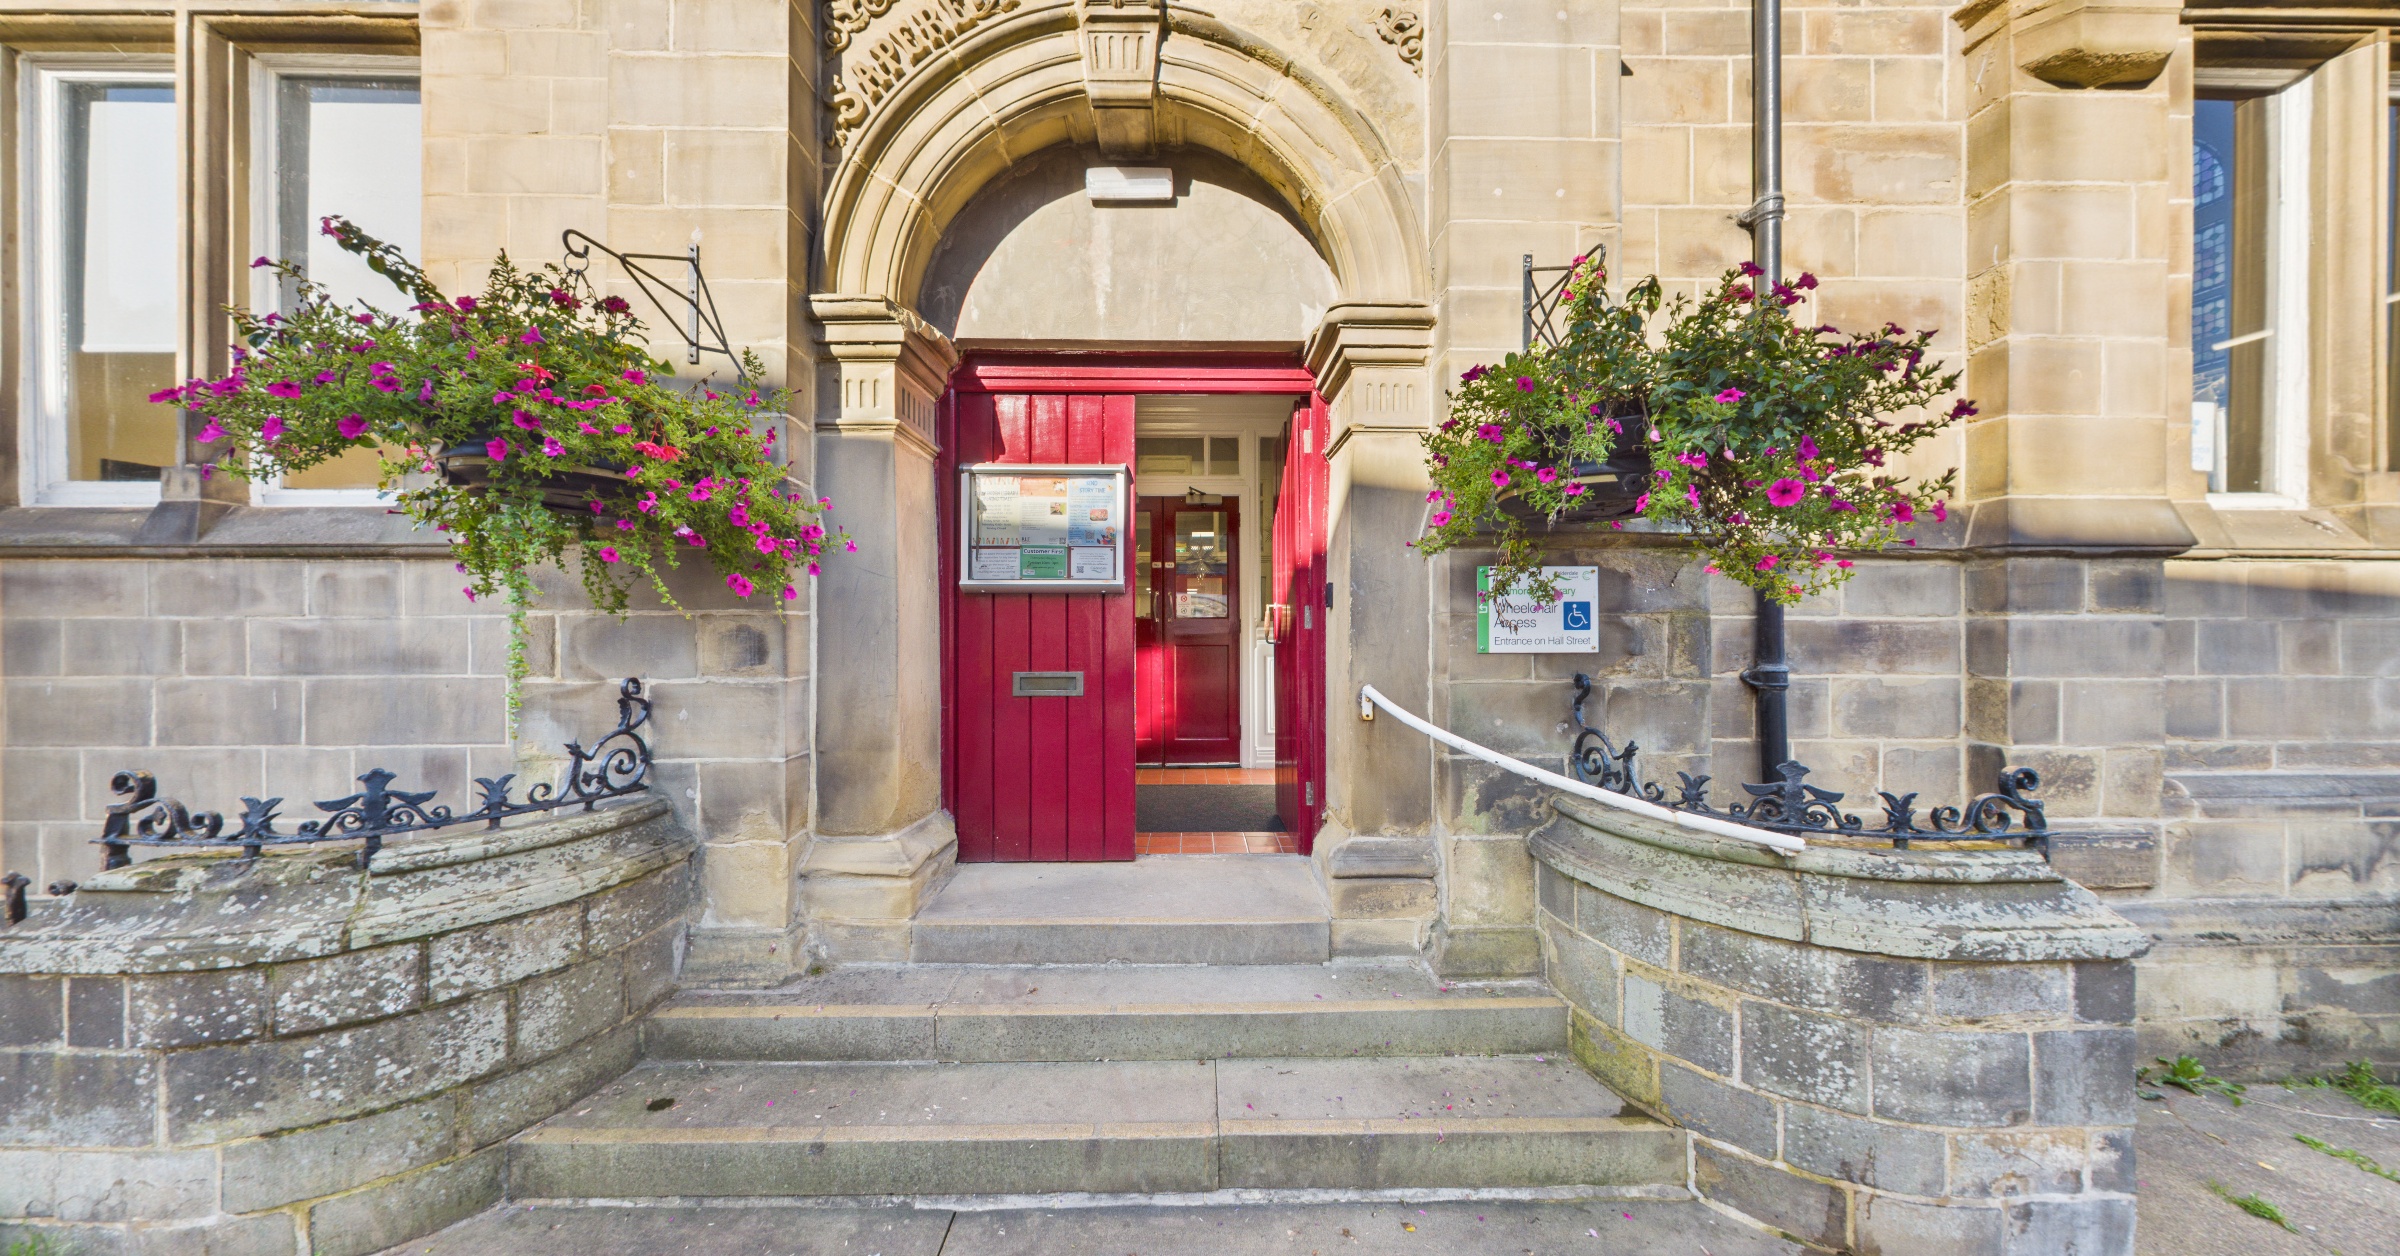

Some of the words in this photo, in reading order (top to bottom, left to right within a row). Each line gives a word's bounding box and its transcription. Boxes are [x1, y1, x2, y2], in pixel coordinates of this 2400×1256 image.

[824, 0, 980, 147] SAPERE
[1493, 616, 1537, 628] Access
[1494, 636, 1533, 646] Entrance
[1534, 638, 1546, 646] on
[1547, 636, 1564, 645] Hall
[1566, 636, 1591, 645] Street
